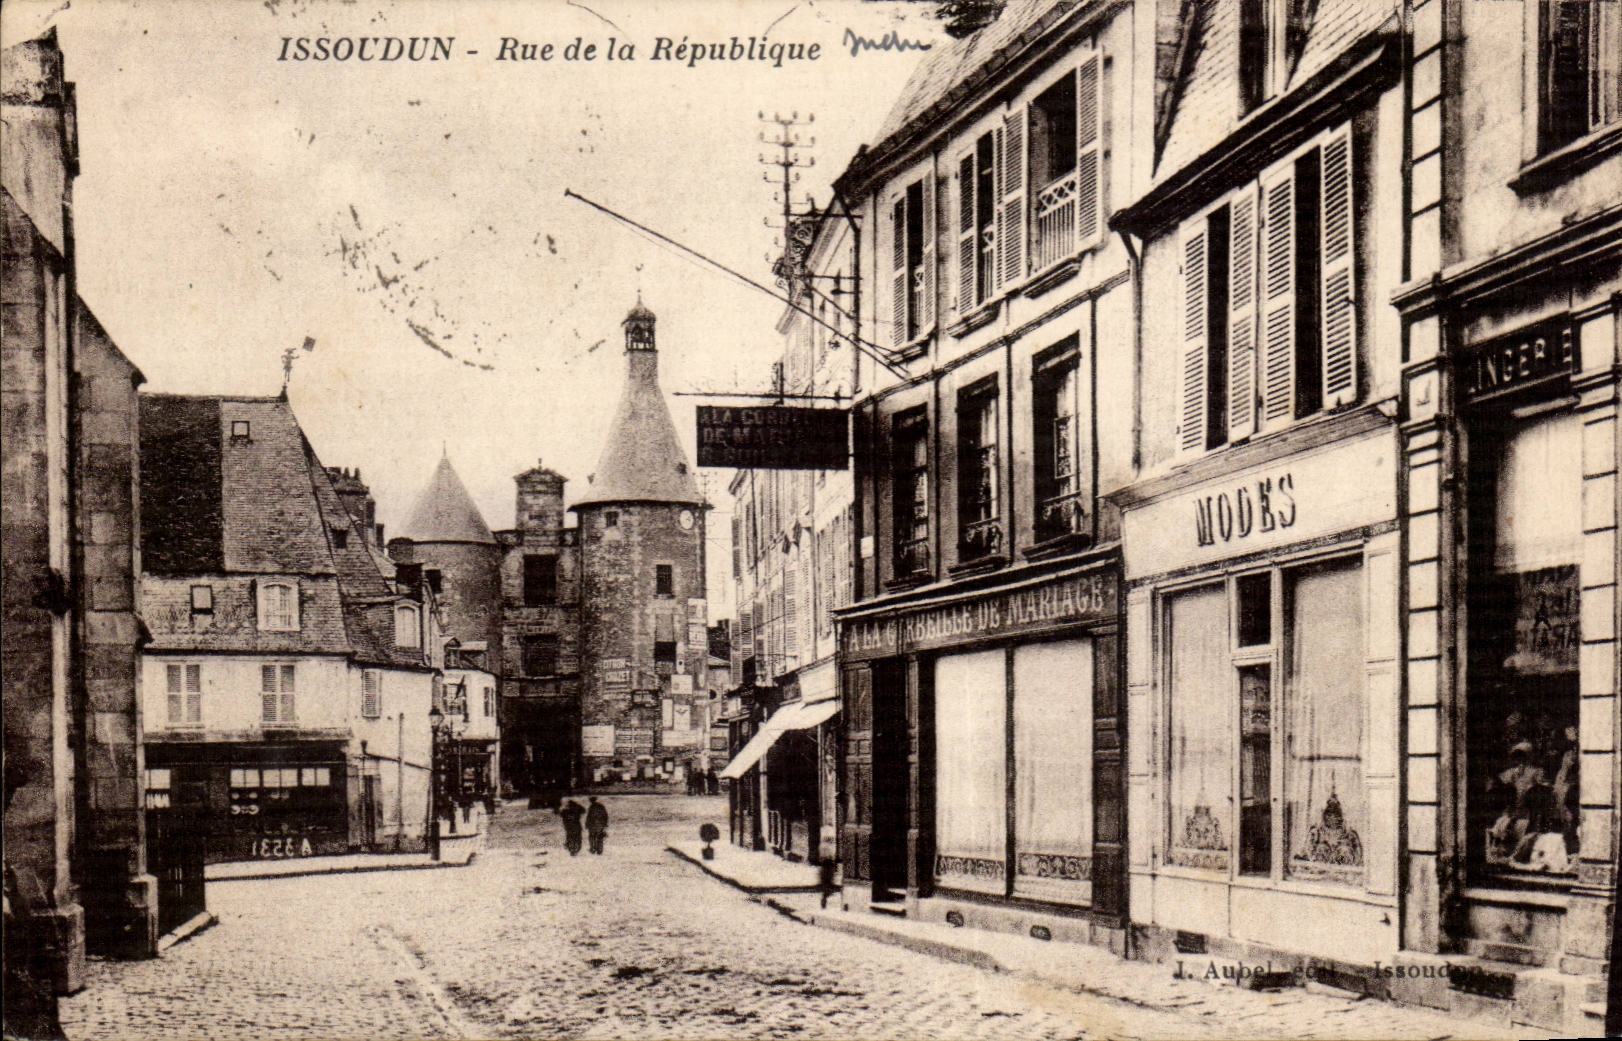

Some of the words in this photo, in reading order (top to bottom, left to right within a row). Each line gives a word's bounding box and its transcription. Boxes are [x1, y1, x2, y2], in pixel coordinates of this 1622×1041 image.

[1194, 472, 1297, 548] MODES
[848, 623, 860, 653] A
[862, 621, 881, 650] LA
[886, 604, 973, 646] CRBEILLE
[978, 600, 1000, 631] DE
[1006, 574, 1104, 626] MARIAGE
